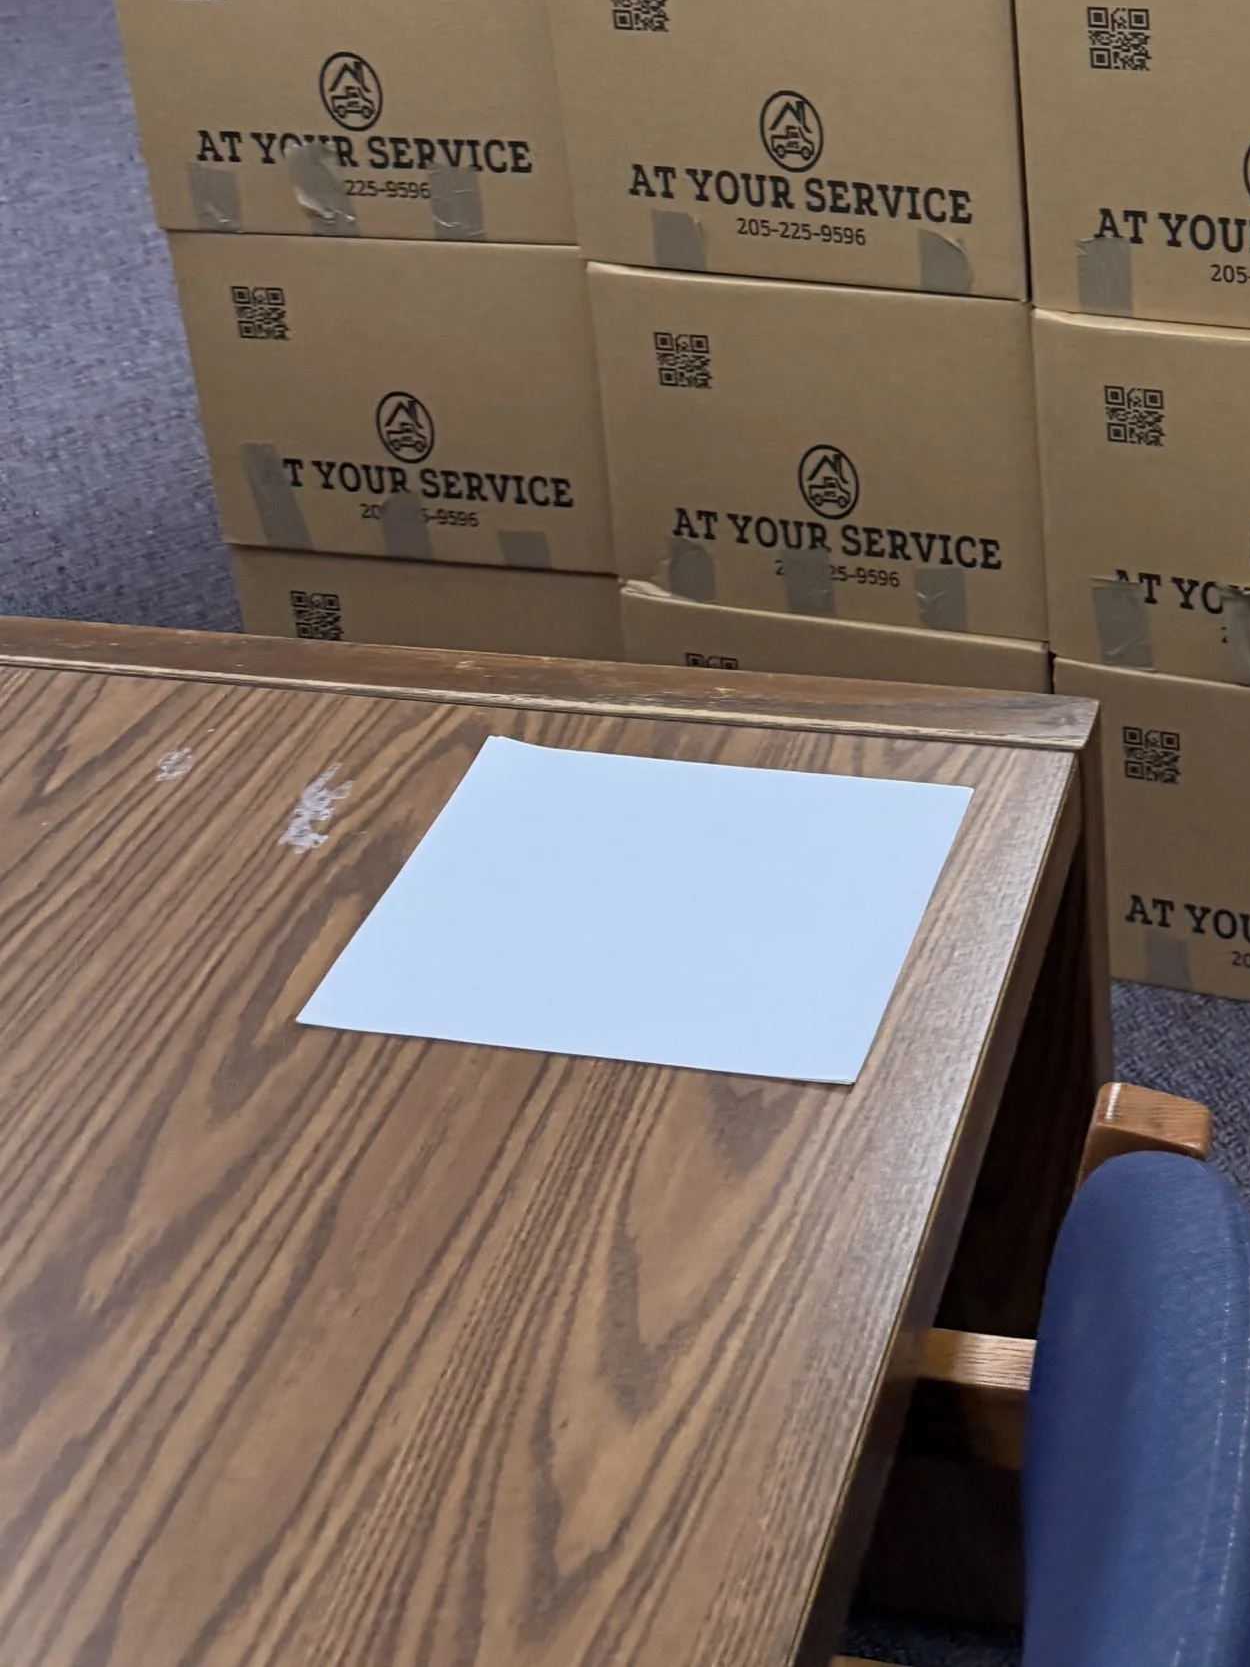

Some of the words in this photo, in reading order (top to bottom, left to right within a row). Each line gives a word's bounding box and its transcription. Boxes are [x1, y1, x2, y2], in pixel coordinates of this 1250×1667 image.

[197, 130, 243, 163] AT
[367, 136, 533, 174] SERVICE
[629, 164, 676, 199] AT
[685, 168, 795, 210] YOUR
[805, 177, 973, 224] SERVICE
[737, 218, 866, 246] 205-225-9596
[1095, 208, 1147, 245] AT
[310, 460, 411, 494] YOUR
[419, 468, 574, 508] SERVICE
[673, 508, 718, 540] AT
[727, 513, 832, 553] YOUR
[841, 525, 1003, 570] SERVICE
[1125, 894, 1174, 928] AT
